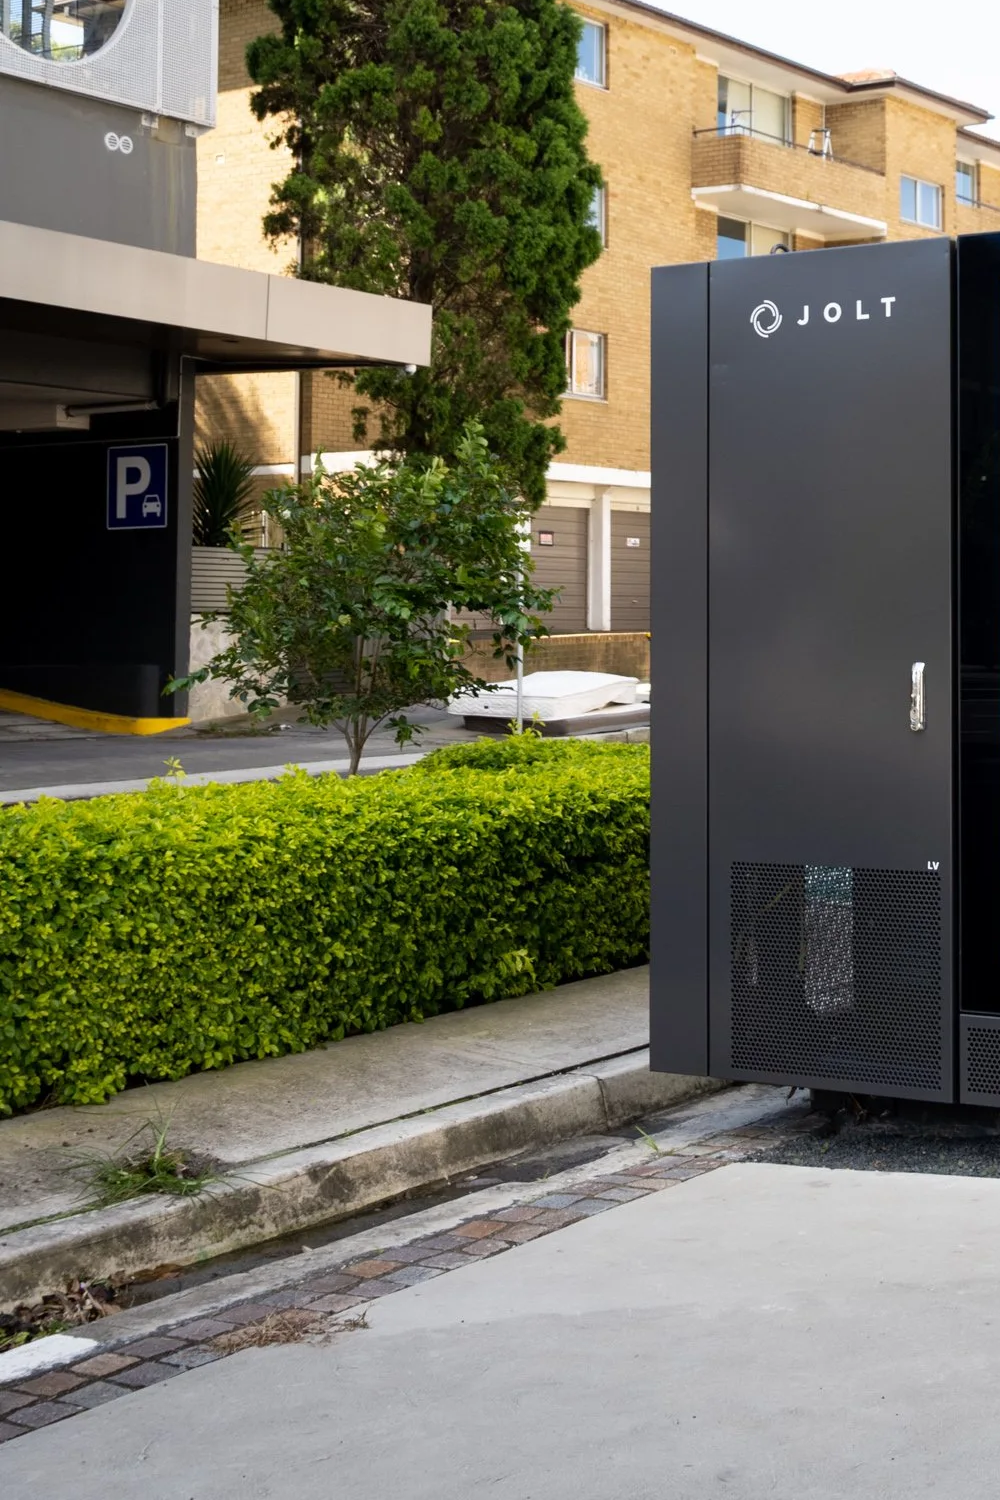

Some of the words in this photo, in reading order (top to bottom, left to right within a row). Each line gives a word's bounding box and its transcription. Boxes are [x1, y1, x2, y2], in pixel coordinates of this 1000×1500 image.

[797, 296, 896, 326] JOLT
[116, 456, 151, 519] P
[927, 860, 940, 870] LV
